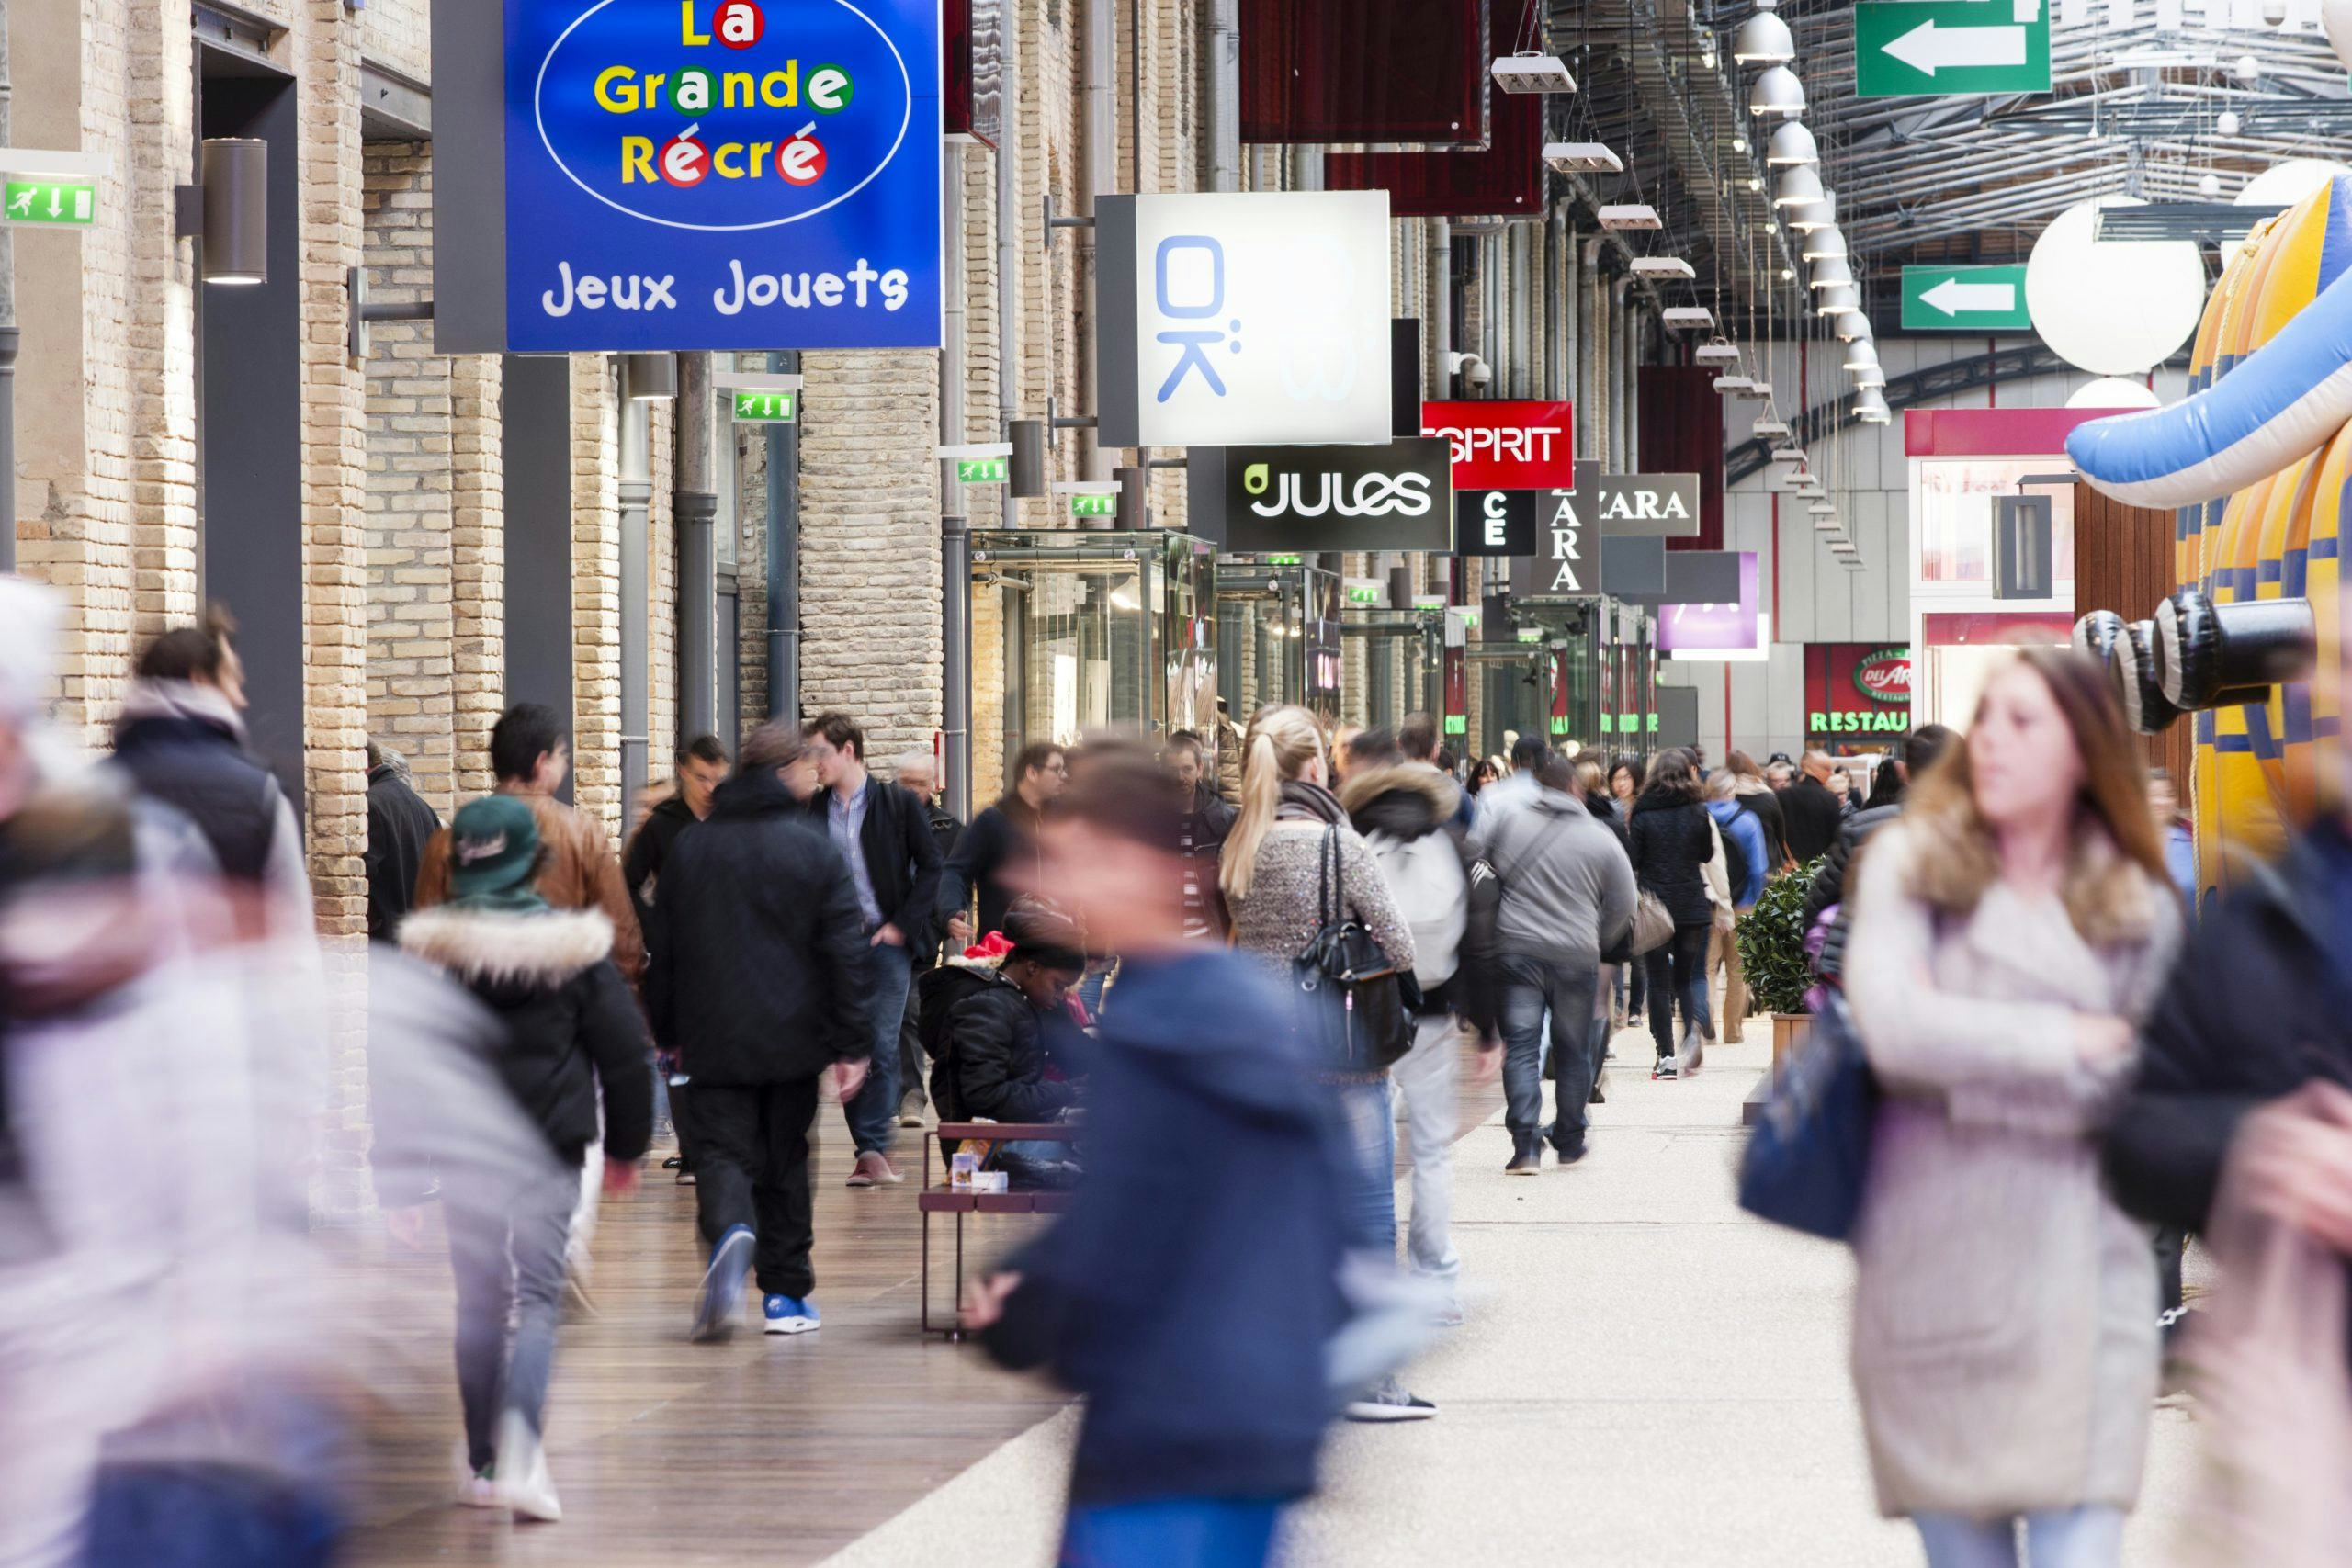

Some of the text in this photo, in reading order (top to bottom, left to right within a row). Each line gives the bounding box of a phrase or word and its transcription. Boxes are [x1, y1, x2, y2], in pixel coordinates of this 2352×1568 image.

[682, 0, 755, 46] La
[594, 60, 848, 114] Grande
[621, 121, 820, 184] Récré
[542, 261, 676, 317] Jeux
[713, 258, 909, 315] Jouets
[1422, 427, 1562, 463] SPRIT
[1811, 711, 1908, 732] RESTAU
